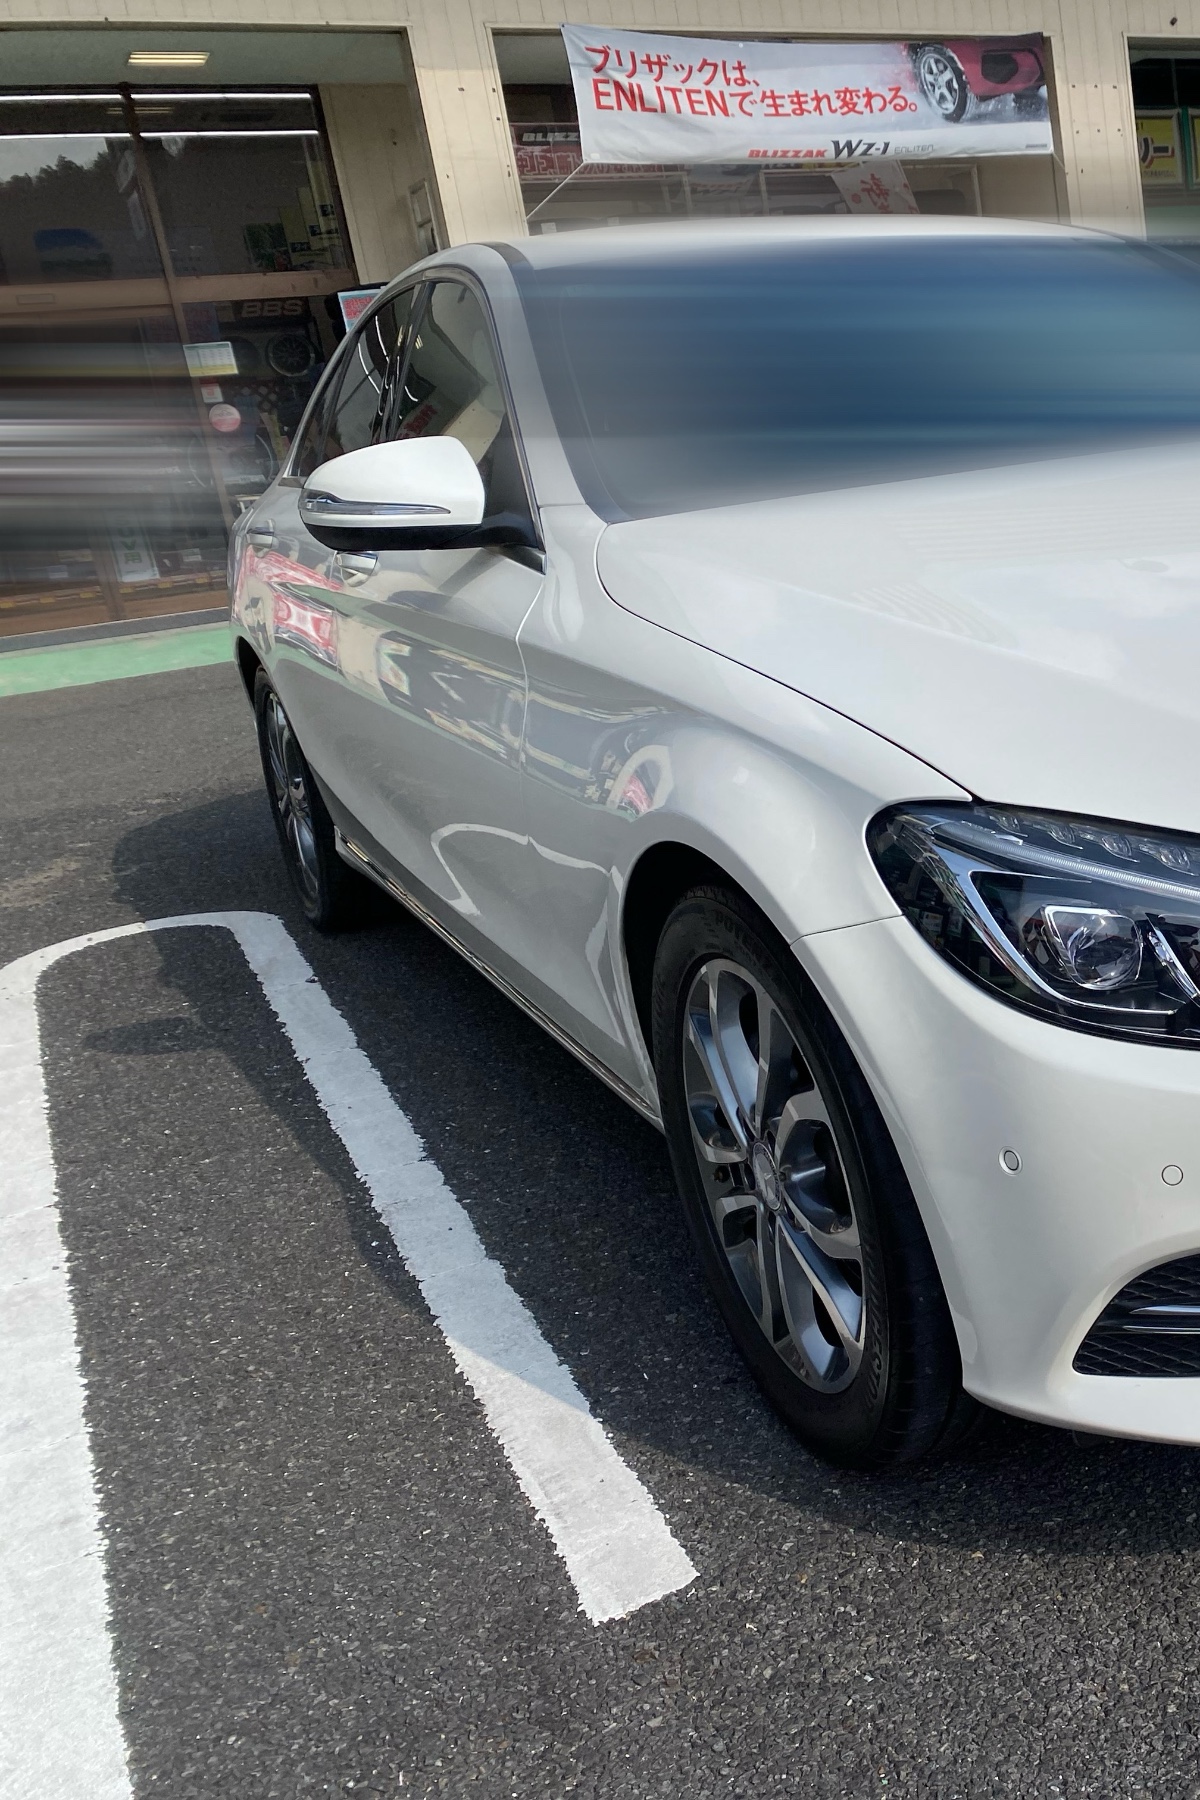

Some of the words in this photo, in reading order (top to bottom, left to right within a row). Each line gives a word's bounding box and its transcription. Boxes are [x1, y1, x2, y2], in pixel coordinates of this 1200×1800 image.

[584, 45, 760, 87] ブリザックは、
[522, 132, 579, 142] BLIZZ
[748, 148, 828, 158] BLIZZAK
[831, 139, 891, 159] WZ-1
[241, 300, 303, 318] BBS
